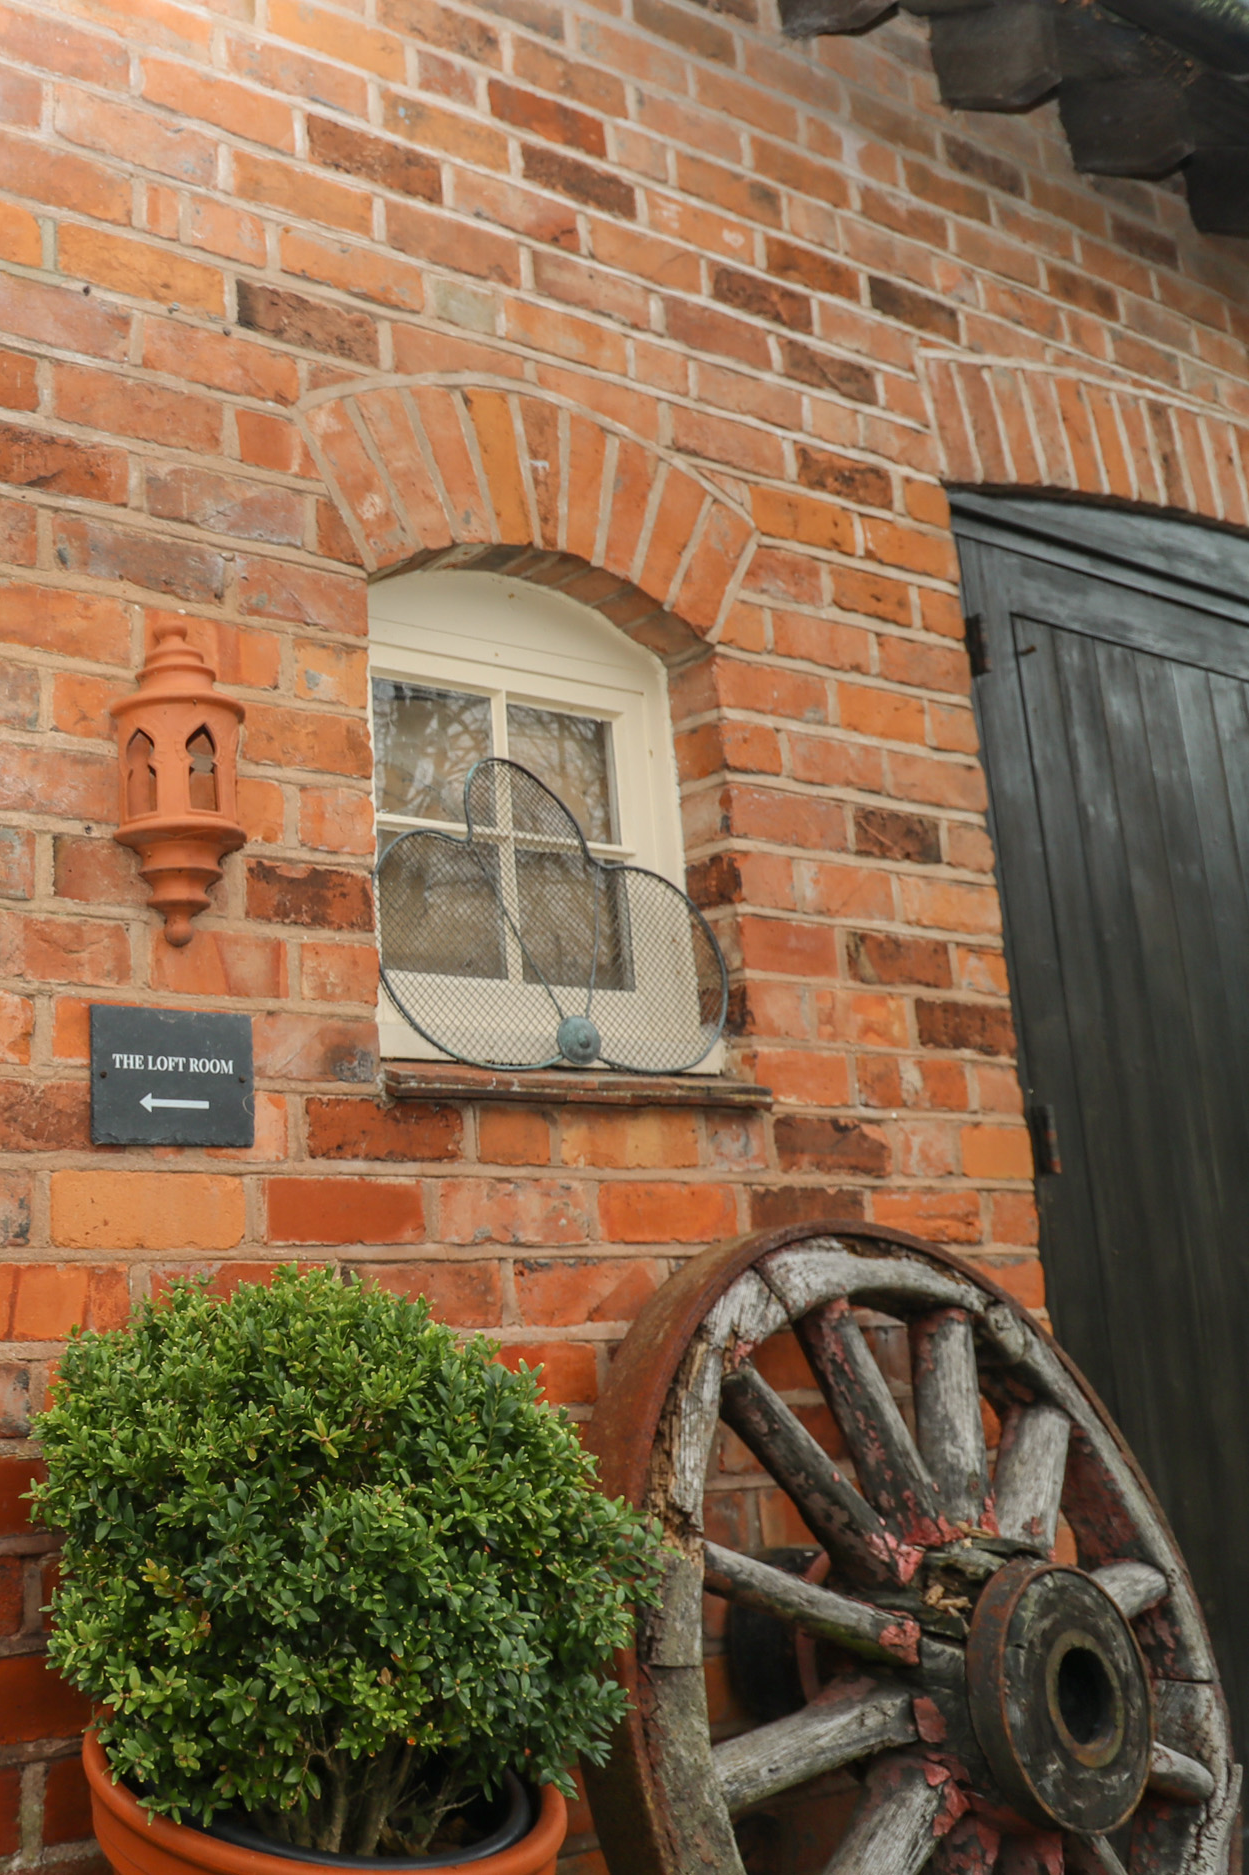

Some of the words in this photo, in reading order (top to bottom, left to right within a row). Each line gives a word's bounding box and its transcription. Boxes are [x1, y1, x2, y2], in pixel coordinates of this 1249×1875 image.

[112, 1053, 144, 1070] THE
[147, 1055, 186, 1072] LOFT
[189, 1058, 234, 1075] ROOM
